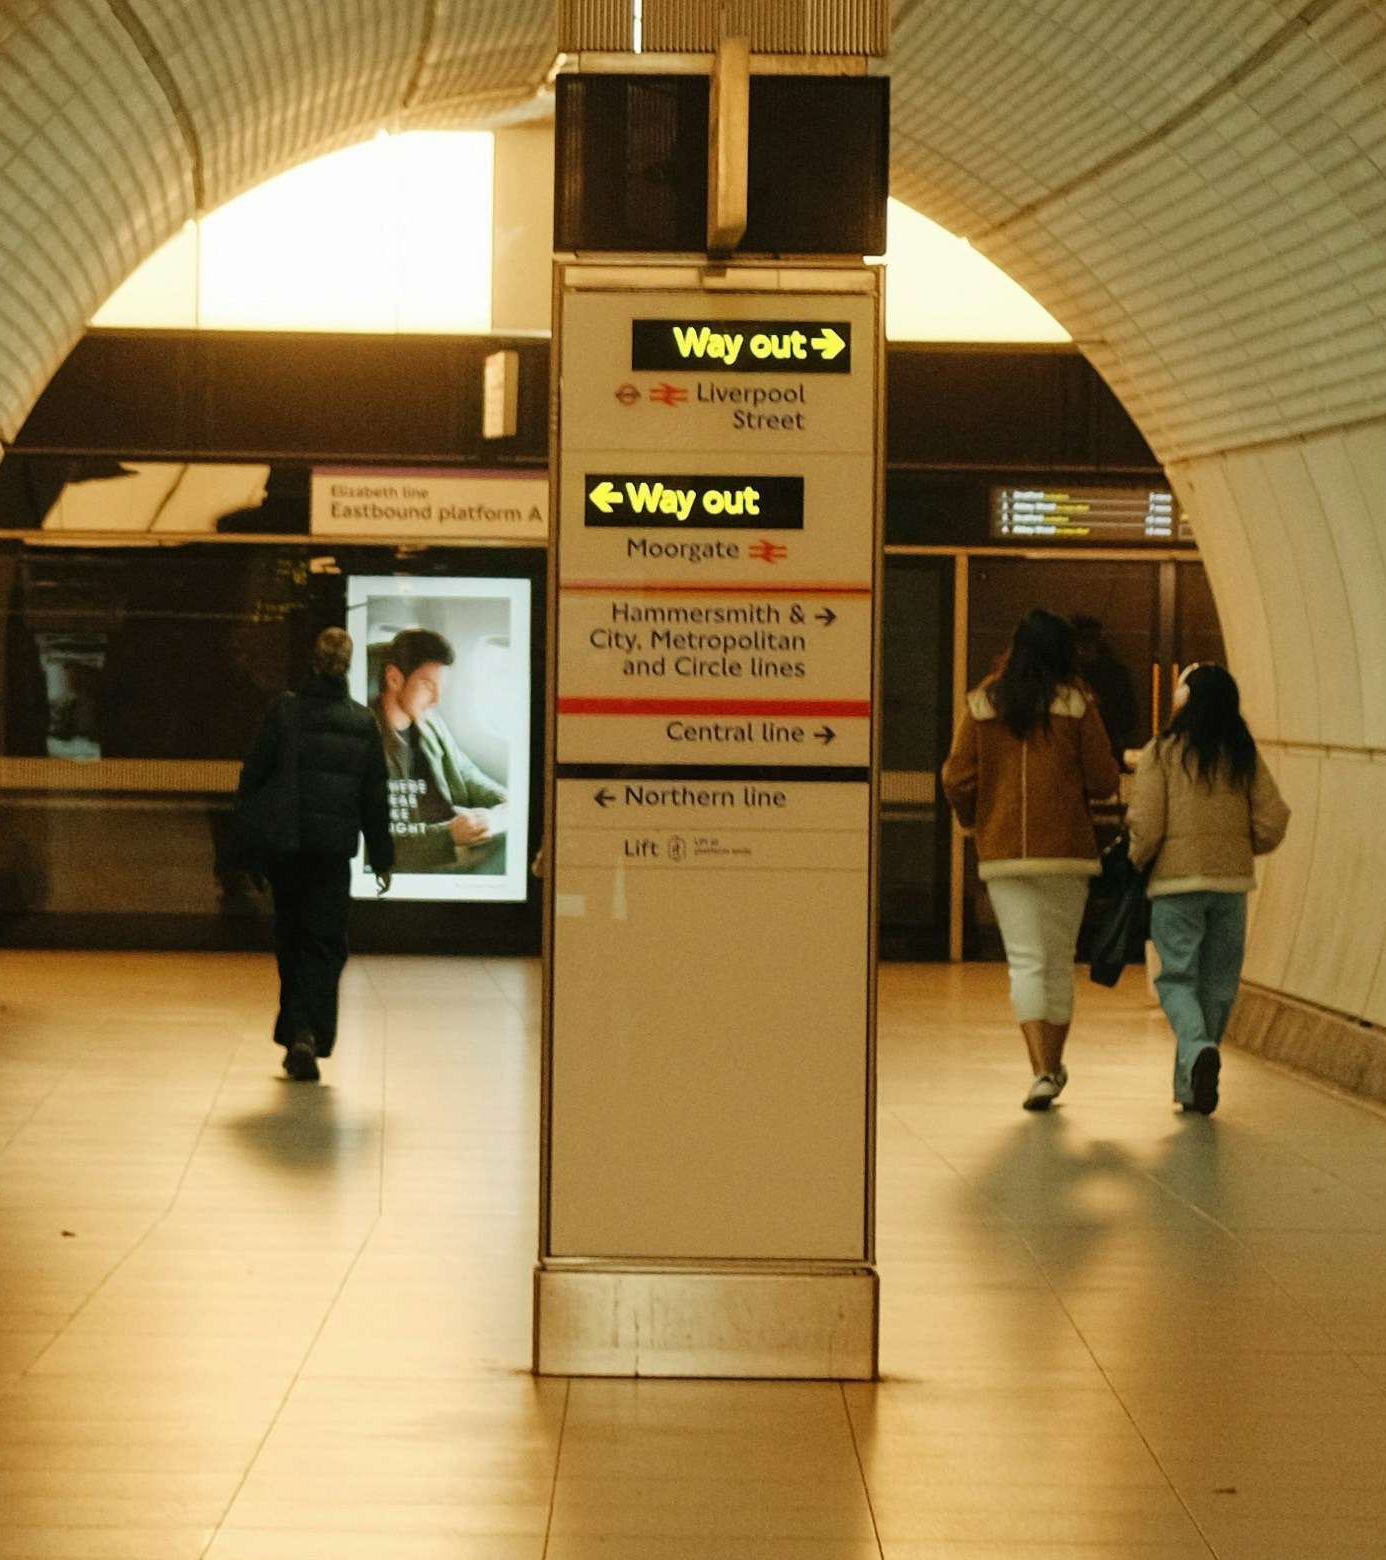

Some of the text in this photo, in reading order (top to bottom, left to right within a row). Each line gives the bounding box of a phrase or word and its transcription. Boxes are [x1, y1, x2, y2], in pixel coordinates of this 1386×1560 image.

[672, 326, 808, 366] Way out
[696, 382, 806, 408] Liverpool
[733, 408, 804, 431] Street
[330, 484, 430, 500] Elizabeth line
[625, 482, 760, 521] Way out
[330, 501, 543, 524] Eastbound platform A
[626, 537, 740, 563] Moorgate
[612, 602, 805, 625] Hammersmith &
[589, 628, 806, 655] City, Metropolitan
[622, 656, 806, 678] and Circle lines
[666, 720, 805, 743] Central line
[625, 785, 787, 808] Northern line
[624, 839, 658, 857] Lift
